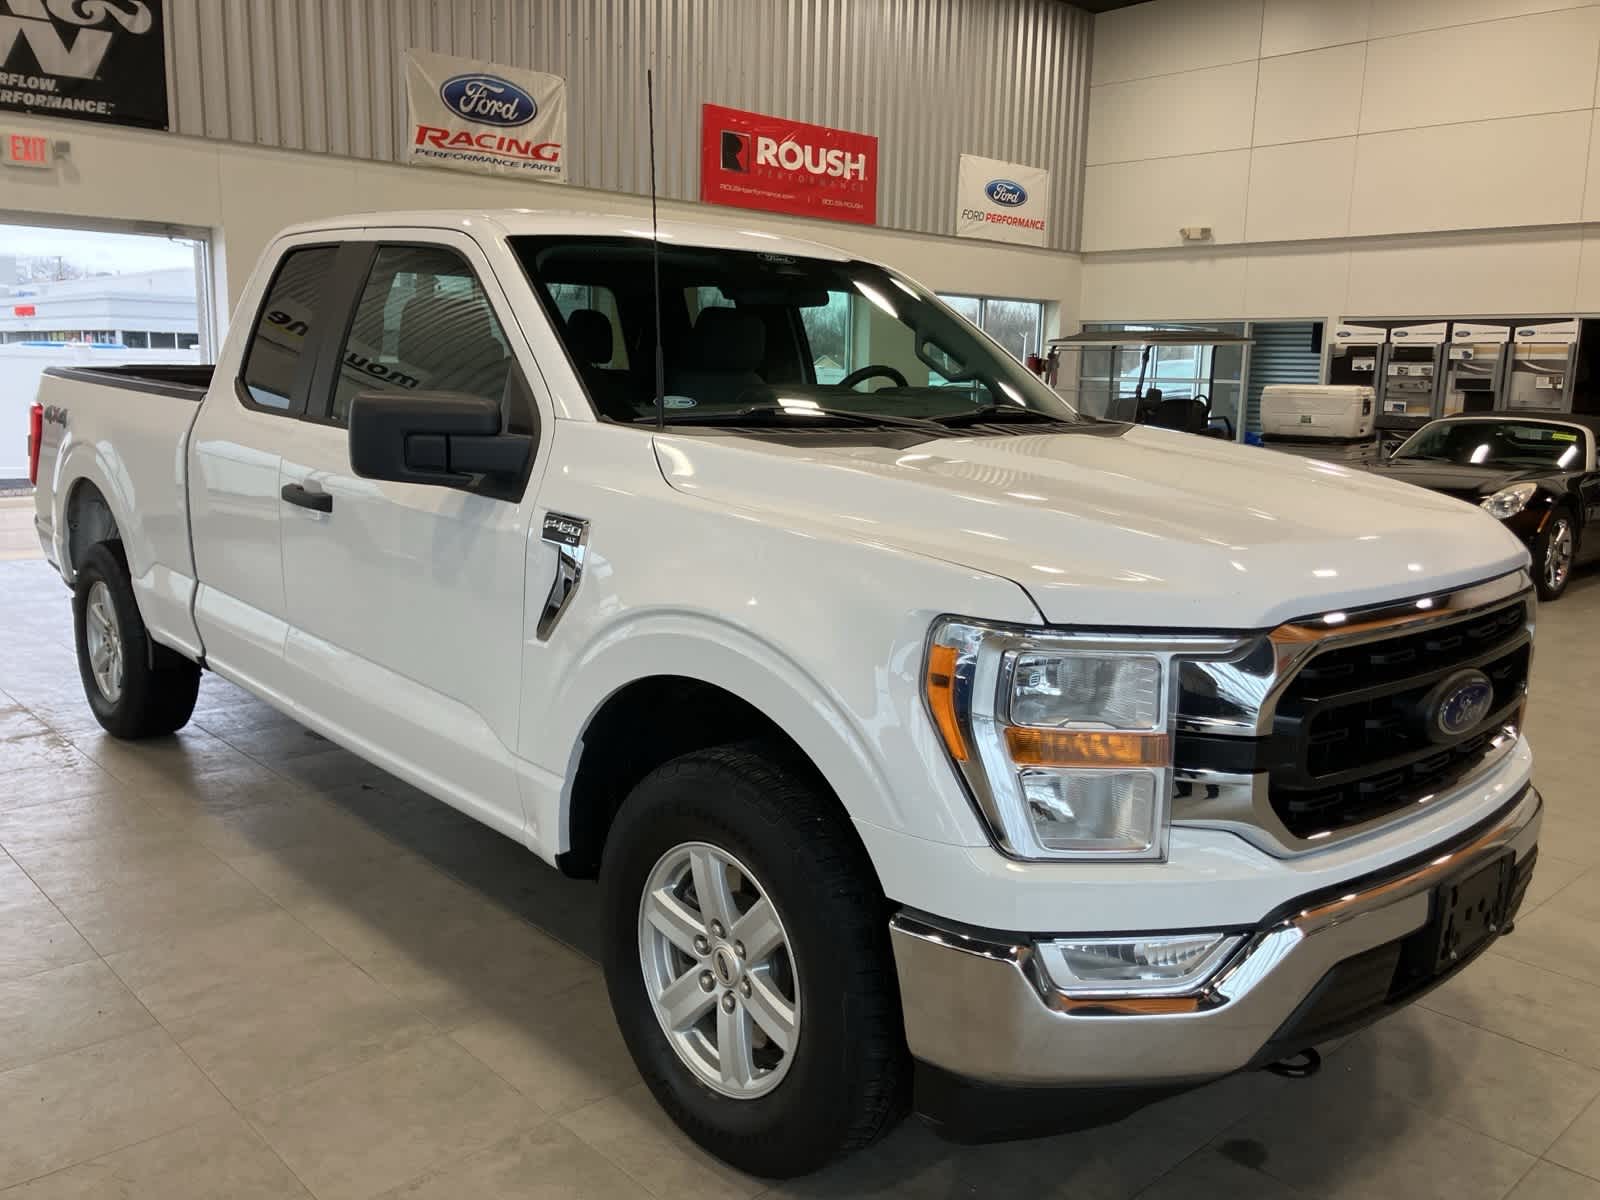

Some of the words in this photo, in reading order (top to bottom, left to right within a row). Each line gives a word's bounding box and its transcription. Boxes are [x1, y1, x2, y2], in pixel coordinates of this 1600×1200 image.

[0, 89, 112, 115] RFORMANCE.
[459, 80, 520, 121] Ford
[10, 134, 46, 162] EXIT
[415, 124, 561, 162] RACING
[415, 148, 519, 167] PERFORMANCE
[522, 162, 561, 173] PARTS
[756, 136, 866, 181] ROUSH
[993, 183, 1020, 203] Ford
[961, 209, 985, 221] FORD
[985, 212, 1045, 231] PERFORMANCE
